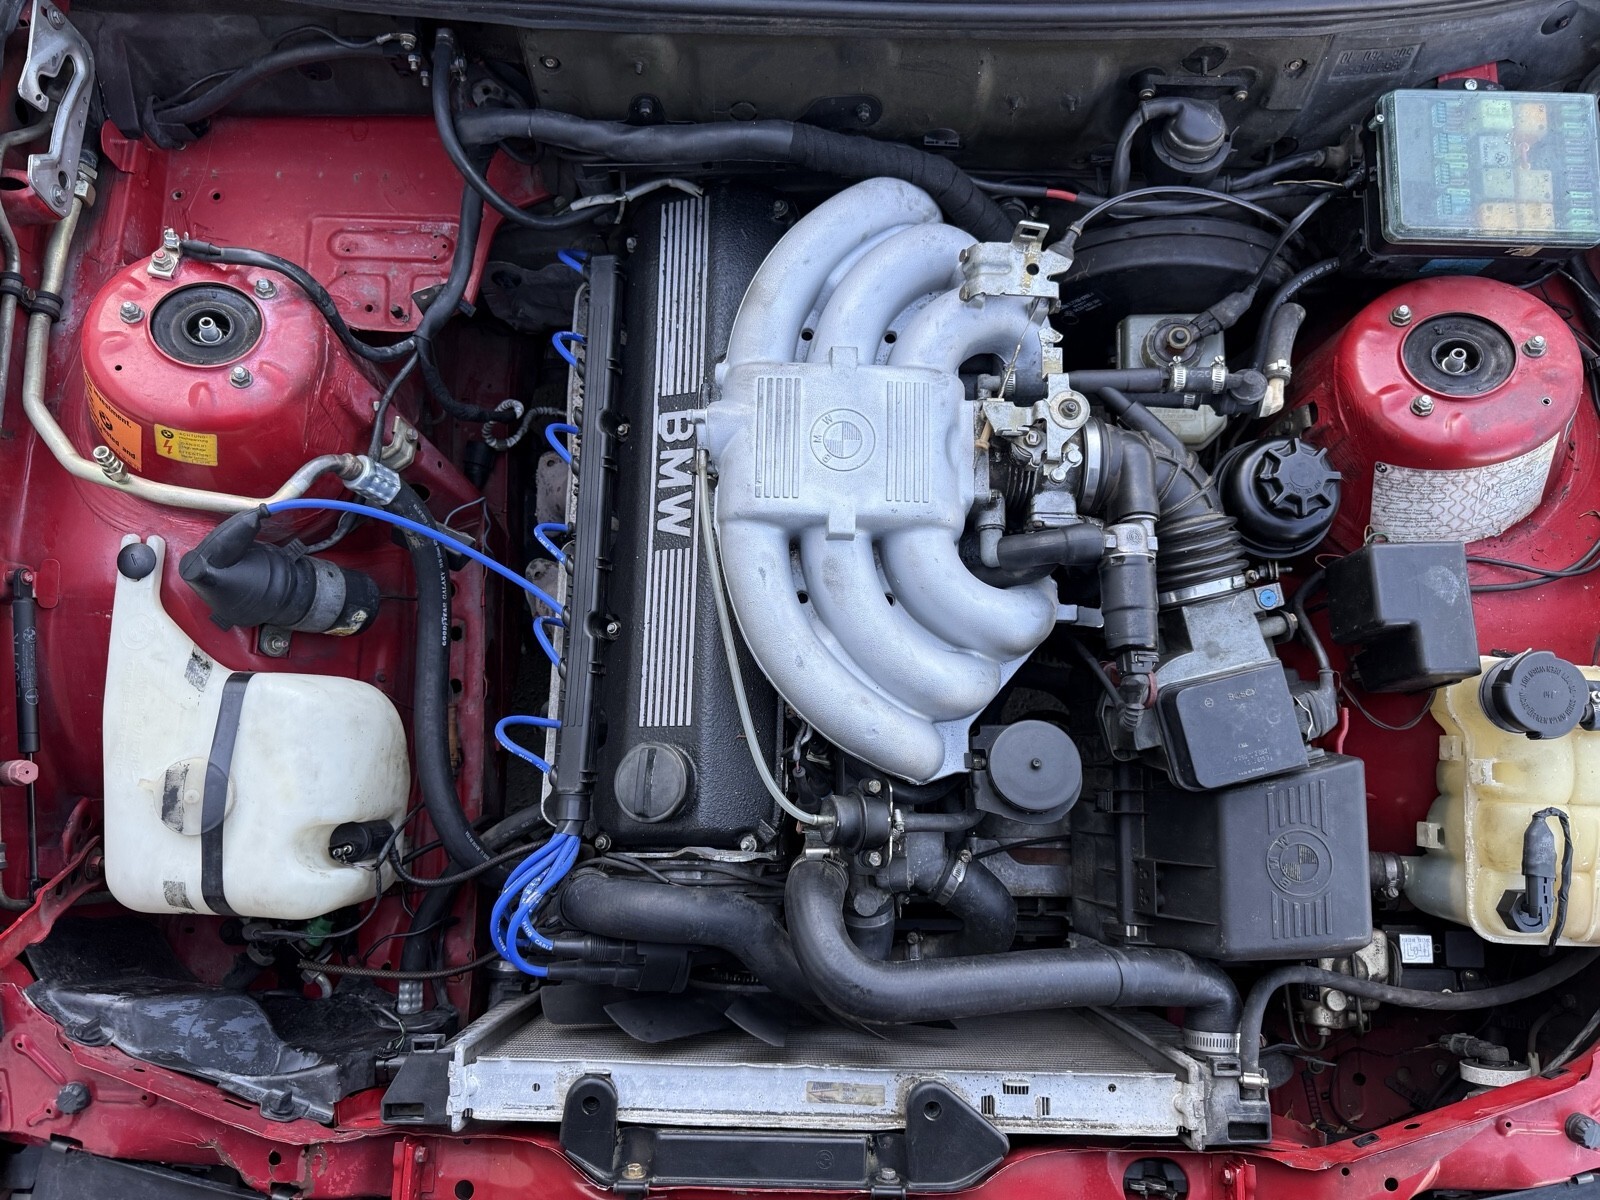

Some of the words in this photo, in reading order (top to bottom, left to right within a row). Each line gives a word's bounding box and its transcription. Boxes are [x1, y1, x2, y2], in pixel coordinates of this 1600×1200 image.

[1286, 281, 1302, 299] CHINA
[1301, 271, 1315, 283] MAX
[812, 414, 834, 464] BMW
[122, 447, 136, 460] and
[656, 410, 696, 538] BMW
[440, 571, 448, 600] GALAXY
[522, 920, 533, 938] PLUG
